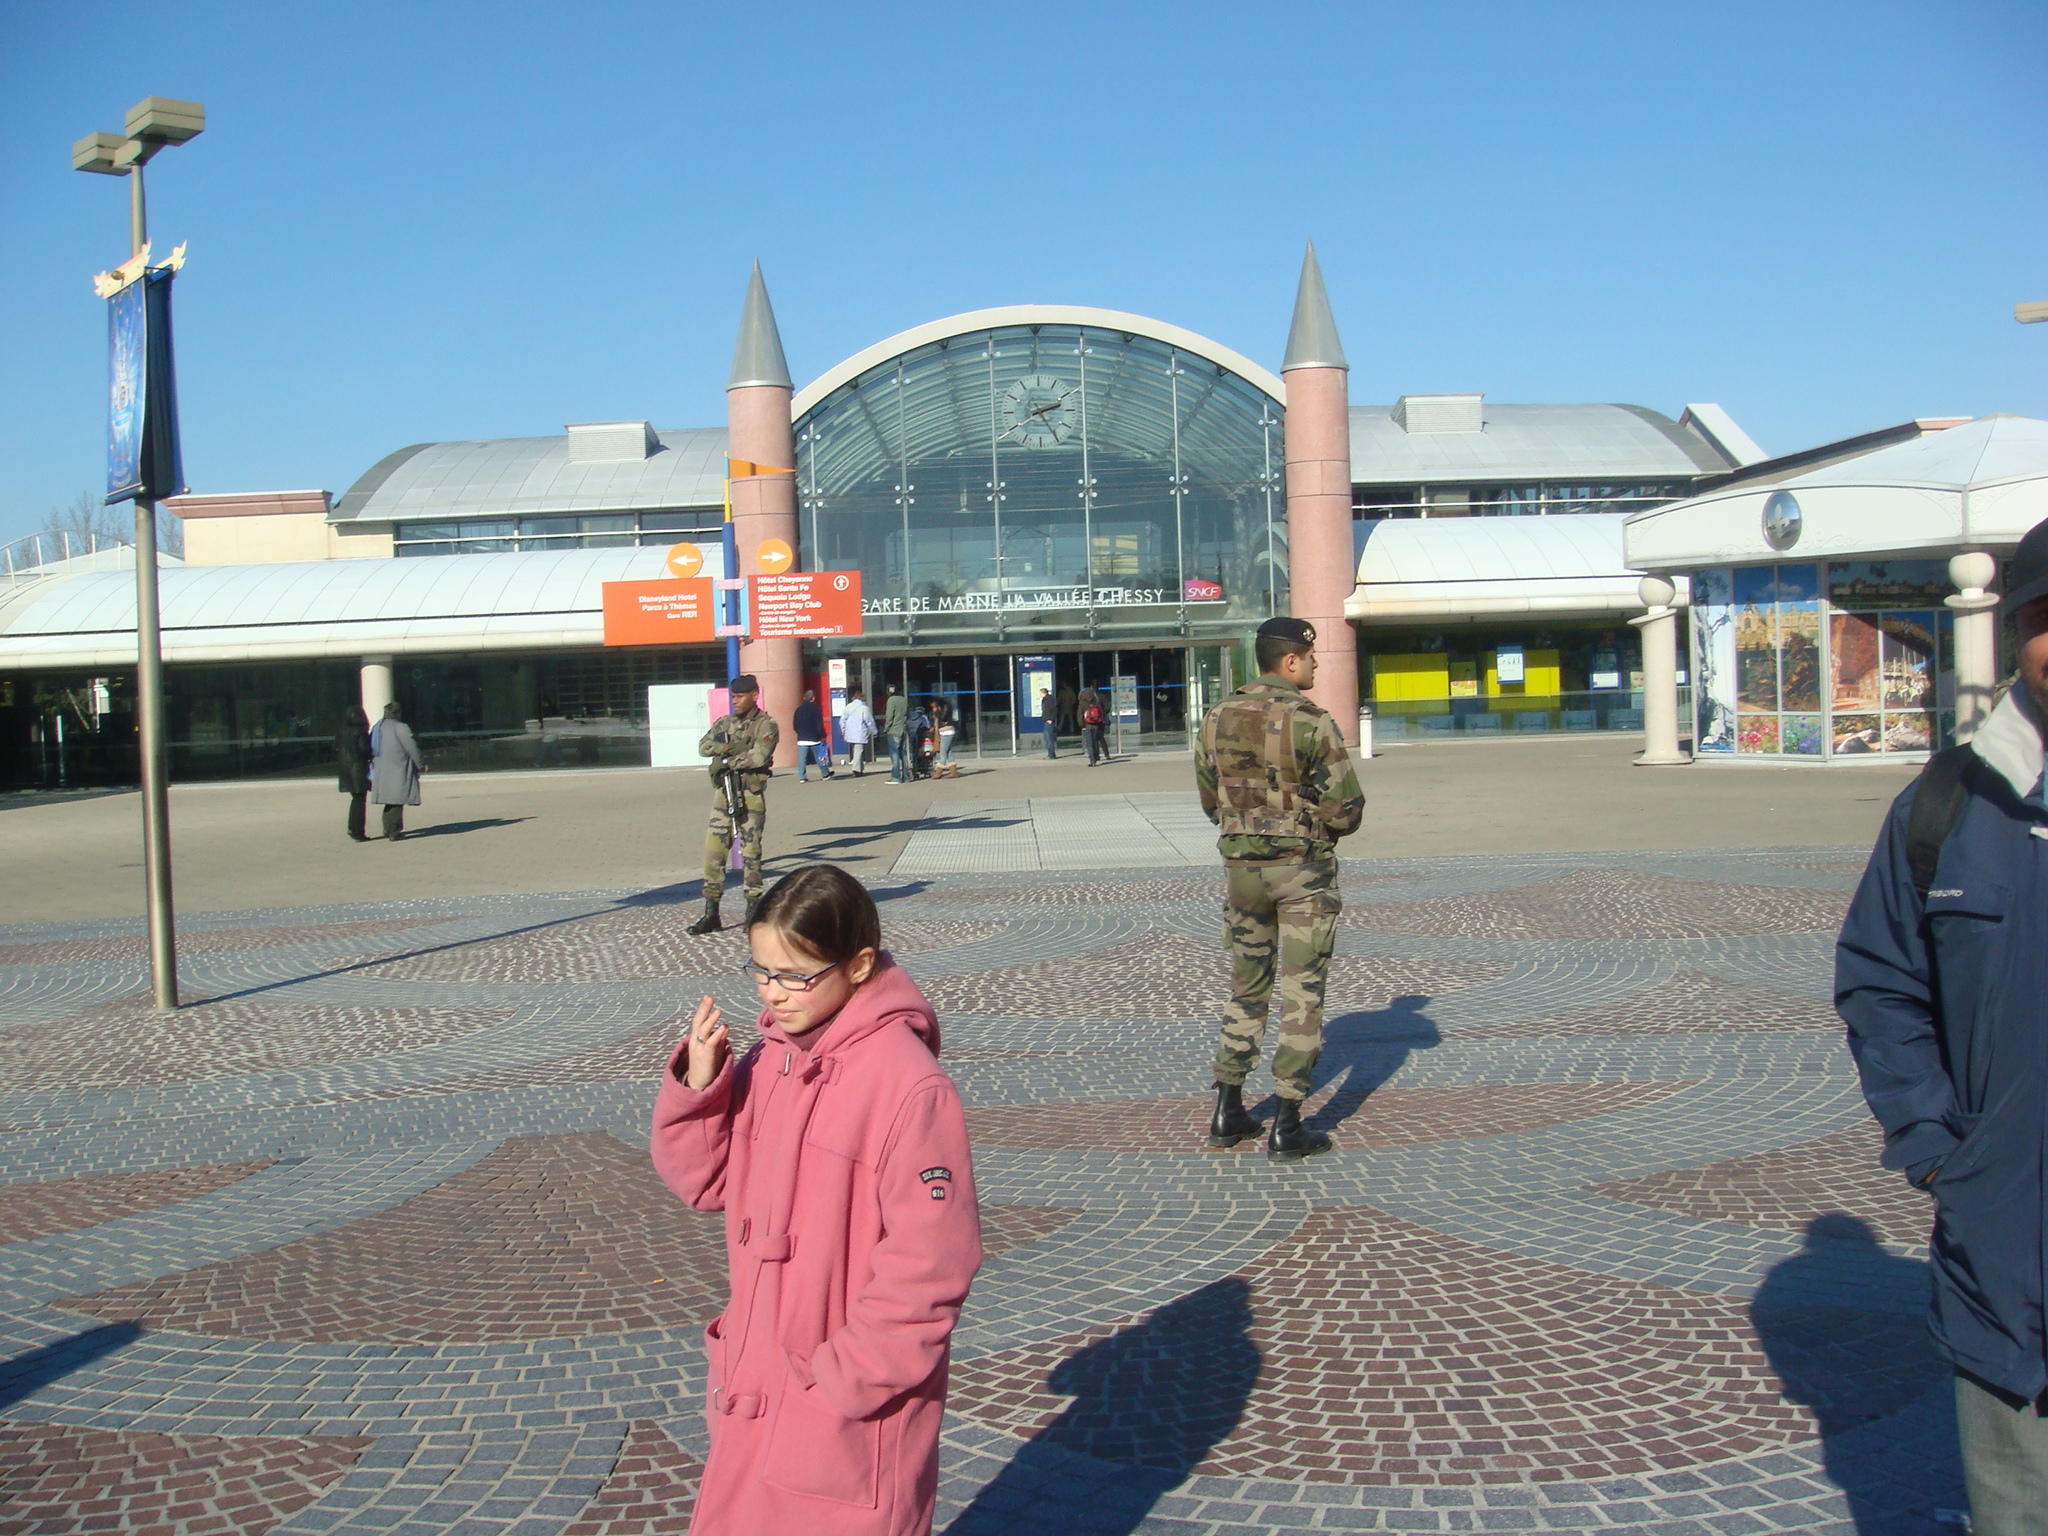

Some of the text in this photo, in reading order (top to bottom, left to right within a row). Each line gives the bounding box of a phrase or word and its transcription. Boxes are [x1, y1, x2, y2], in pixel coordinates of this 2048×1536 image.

[777, 575, 813, 584] Cheyenne
[757, 585, 777, 593] Hôtel
[777, 584, 799, 592] Santa
[1187, 587, 1218, 598] SNCF
[639, 595, 677, 603] Disneyland
[861, 588, 1163, 612] GARE DE MARNE LA VALLÉE CHESSY
[758, 602, 789, 610] Newport
[789, 601, 804, 610] Bay
[681, 610, 697, 618] RER
[779, 615, 795, 623] New
[795, 614, 812, 622] York
[793, 626, 834, 635] Information
